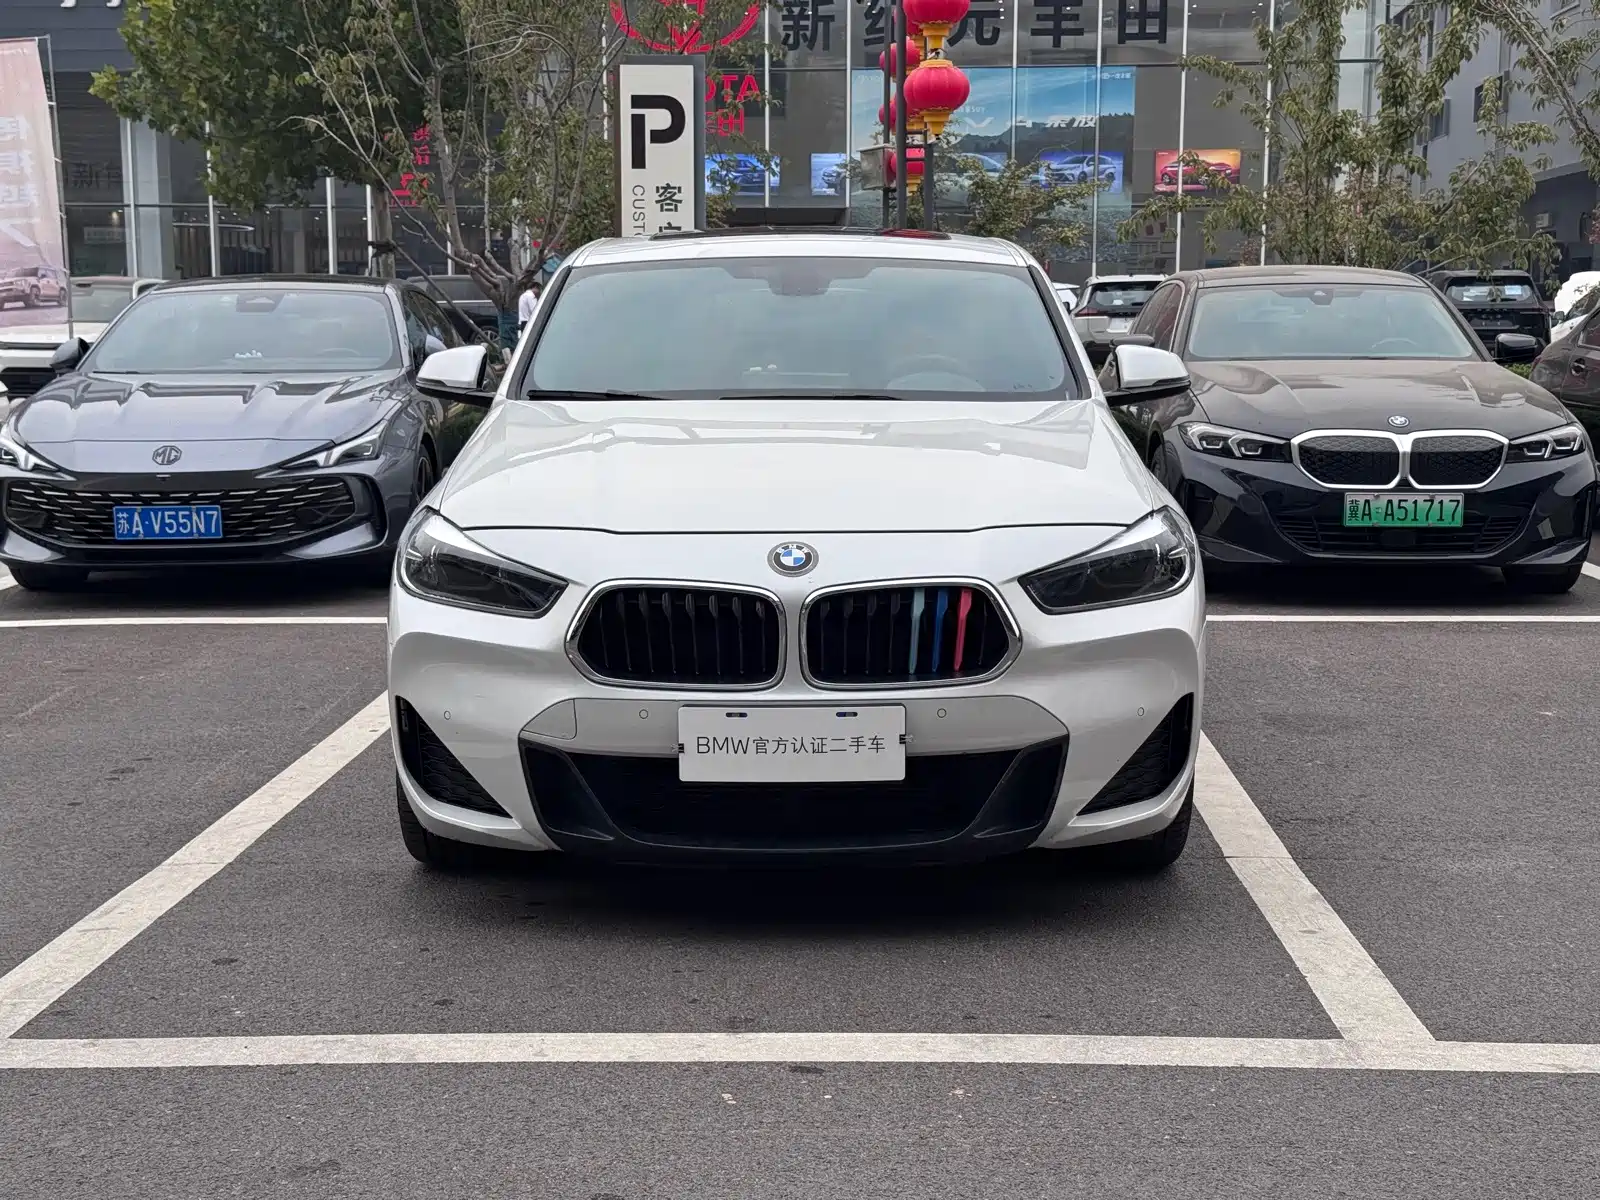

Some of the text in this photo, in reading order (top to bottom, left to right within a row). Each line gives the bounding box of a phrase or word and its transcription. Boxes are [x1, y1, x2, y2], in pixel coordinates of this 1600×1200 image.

[631, 94, 686, 170] P
[632, 184, 646, 237] CUST
[153, 445, 181, 465] MG
[695, 735, 887, 755] BMW官方认证二手车
